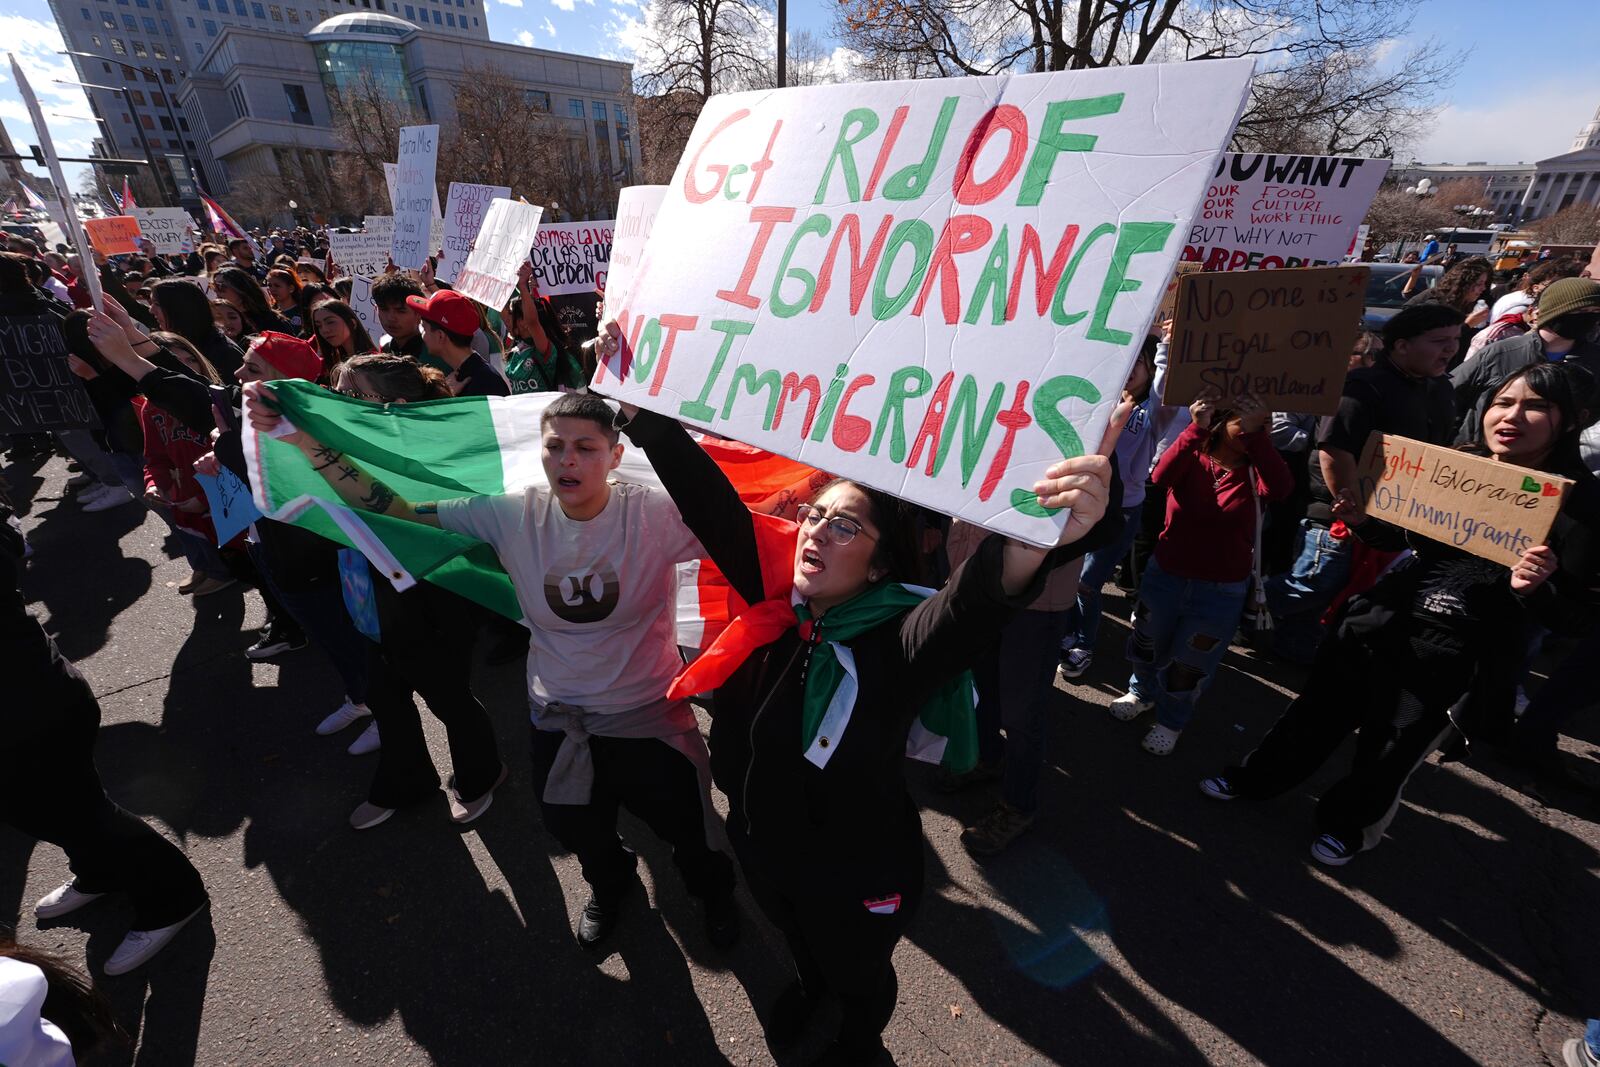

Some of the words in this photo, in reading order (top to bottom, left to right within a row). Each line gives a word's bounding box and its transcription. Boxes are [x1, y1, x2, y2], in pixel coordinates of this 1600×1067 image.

[683, 108, 783, 204] Get
[952, 92, 1125, 207] OF
[1263, 154, 1365, 188] WANT
[451, 183, 494, 201] DON'T
[1207, 184, 1240, 198] OUR
[457, 200, 481, 214] BITE
[1203, 198, 1234, 210] OUR
[1252, 199, 1324, 212] CULTURE
[140, 219, 174, 230] EXIST
[455, 212, 482, 227] THE
[1203, 209, 1235, 220] OUR
[1250, 211, 1292, 225] WORK
[1299, 213, 1343, 225] ETHIC
[143, 232, 182, 243] NYWAY
[593, 228, 615, 245] VO
[1189, 225, 1228, 244] BUT
[1234, 226, 1275, 245] WHY
[1277, 230, 1319, 246] NOT
[715, 206, 1177, 346] IGNORANCE
[1186, 278, 1234, 322] No
[1247, 285, 1305, 311] one
[595, 309, 699, 397] NOT
[1370, 441, 1425, 482] Fight
